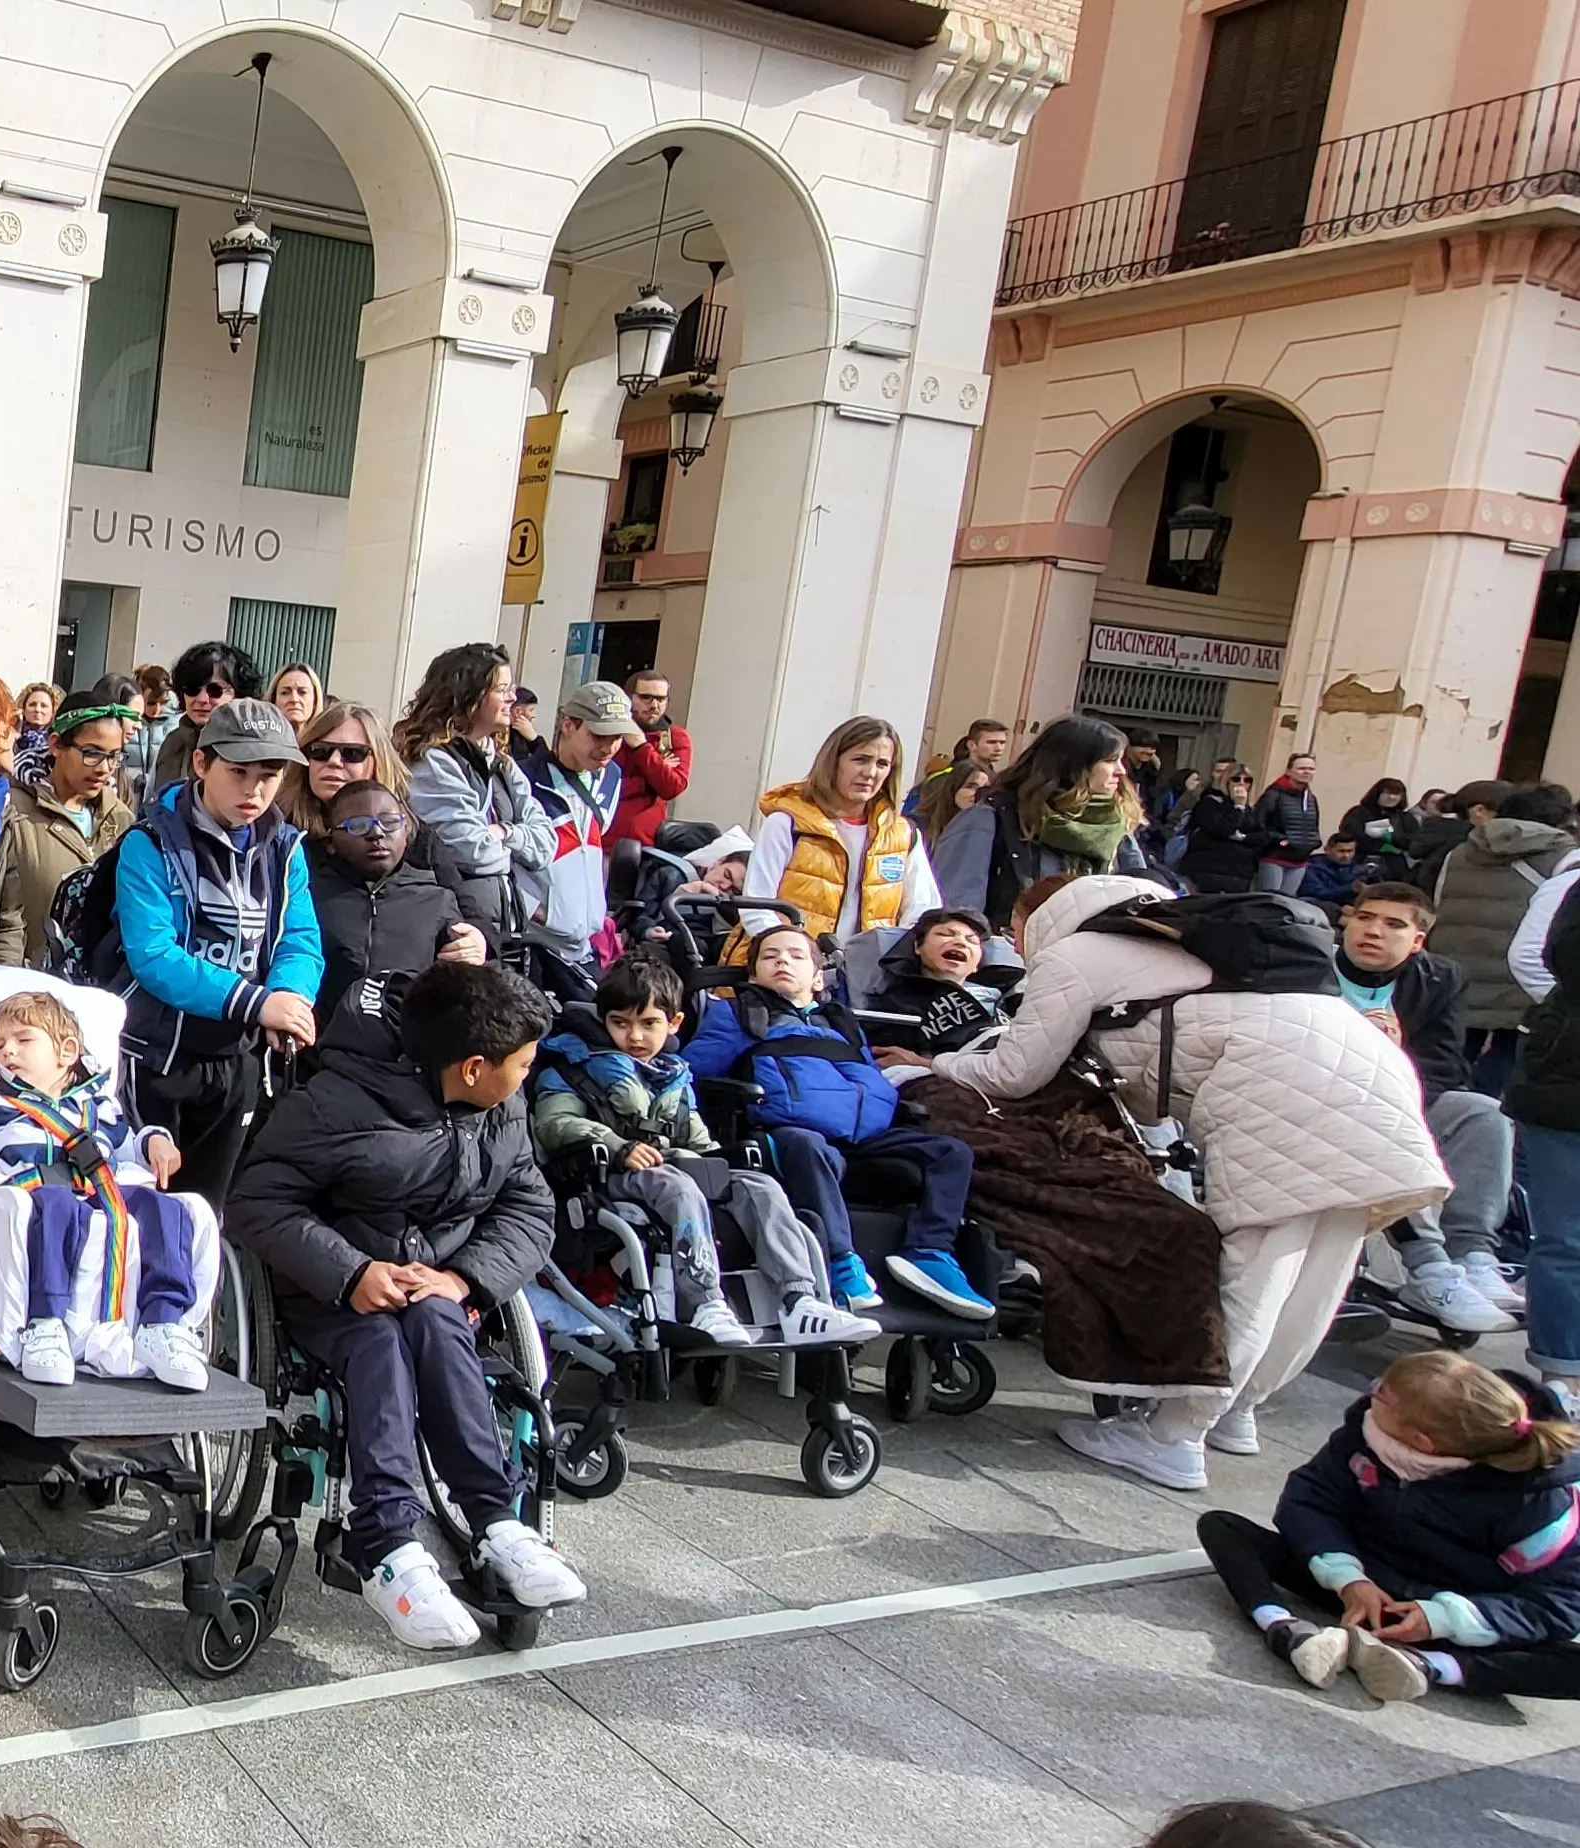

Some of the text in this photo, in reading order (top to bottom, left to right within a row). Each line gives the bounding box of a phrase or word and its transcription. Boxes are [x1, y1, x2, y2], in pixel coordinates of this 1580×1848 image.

[309, 424, 323, 437] es
[264, 430, 325, 452] Naturaleza
[537, 457, 549, 470] de
[518, 473, 547, 485] urismo
[65, 504, 282, 562] TURISMO
[1200, 641, 1251, 667] AMADO
[242, 719, 282, 734] BOSTON
